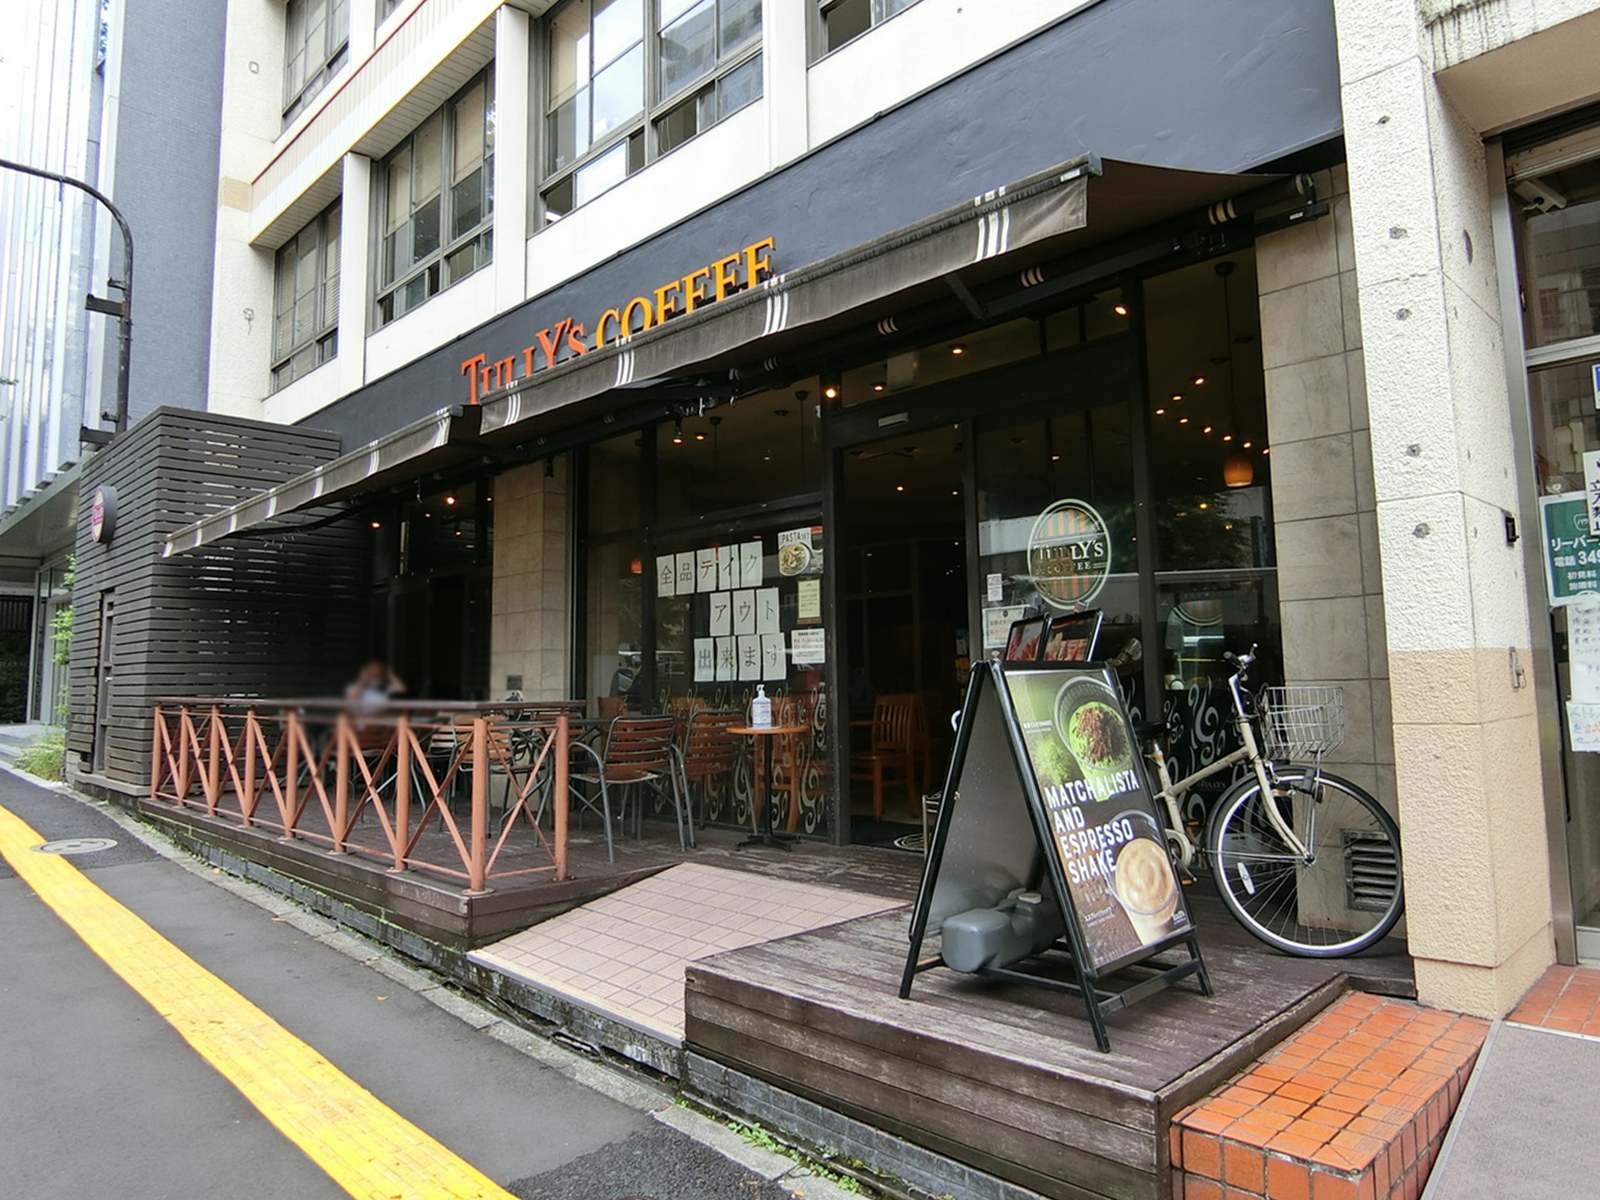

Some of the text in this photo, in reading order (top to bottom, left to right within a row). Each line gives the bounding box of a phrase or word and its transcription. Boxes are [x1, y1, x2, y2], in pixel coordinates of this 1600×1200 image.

[595, 237, 776, 350] COFFEE
[1551, 534, 1600, 552] リーバー
[661, 554, 758, 585] 全品テイク
[1046, 561, 1091, 574] COEE
[714, 600, 774, 623] アウト
[698, 644, 782, 669] 出来ます
[1044, 769, 1140, 810] MATCHALISTA
[1054, 806, 1086, 834] AND
[1060, 818, 1134, 860] ESPRESSO
[1068, 849, 1117, 885] SHAKE
